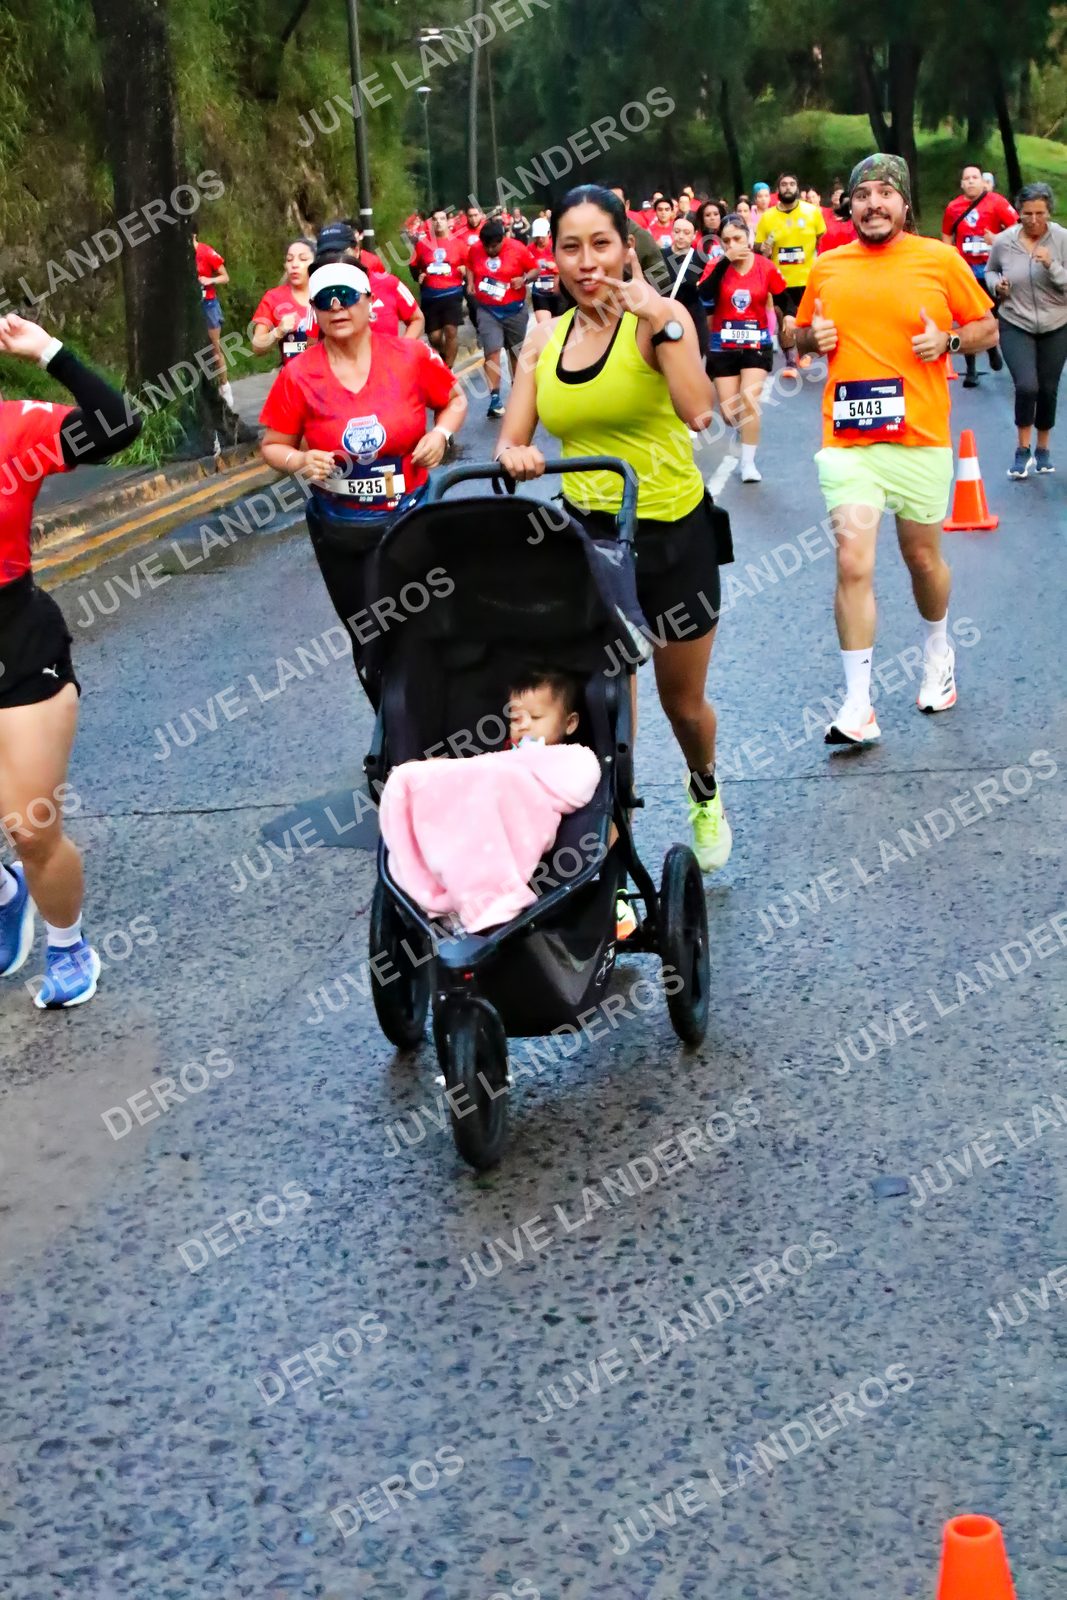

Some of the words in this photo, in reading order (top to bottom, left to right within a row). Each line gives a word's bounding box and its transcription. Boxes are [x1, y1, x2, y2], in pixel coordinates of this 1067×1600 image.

[732, 330, 750, 339] 5093
[849, 400, 882, 417] 5443
[348, 479, 383, 494] 5235
